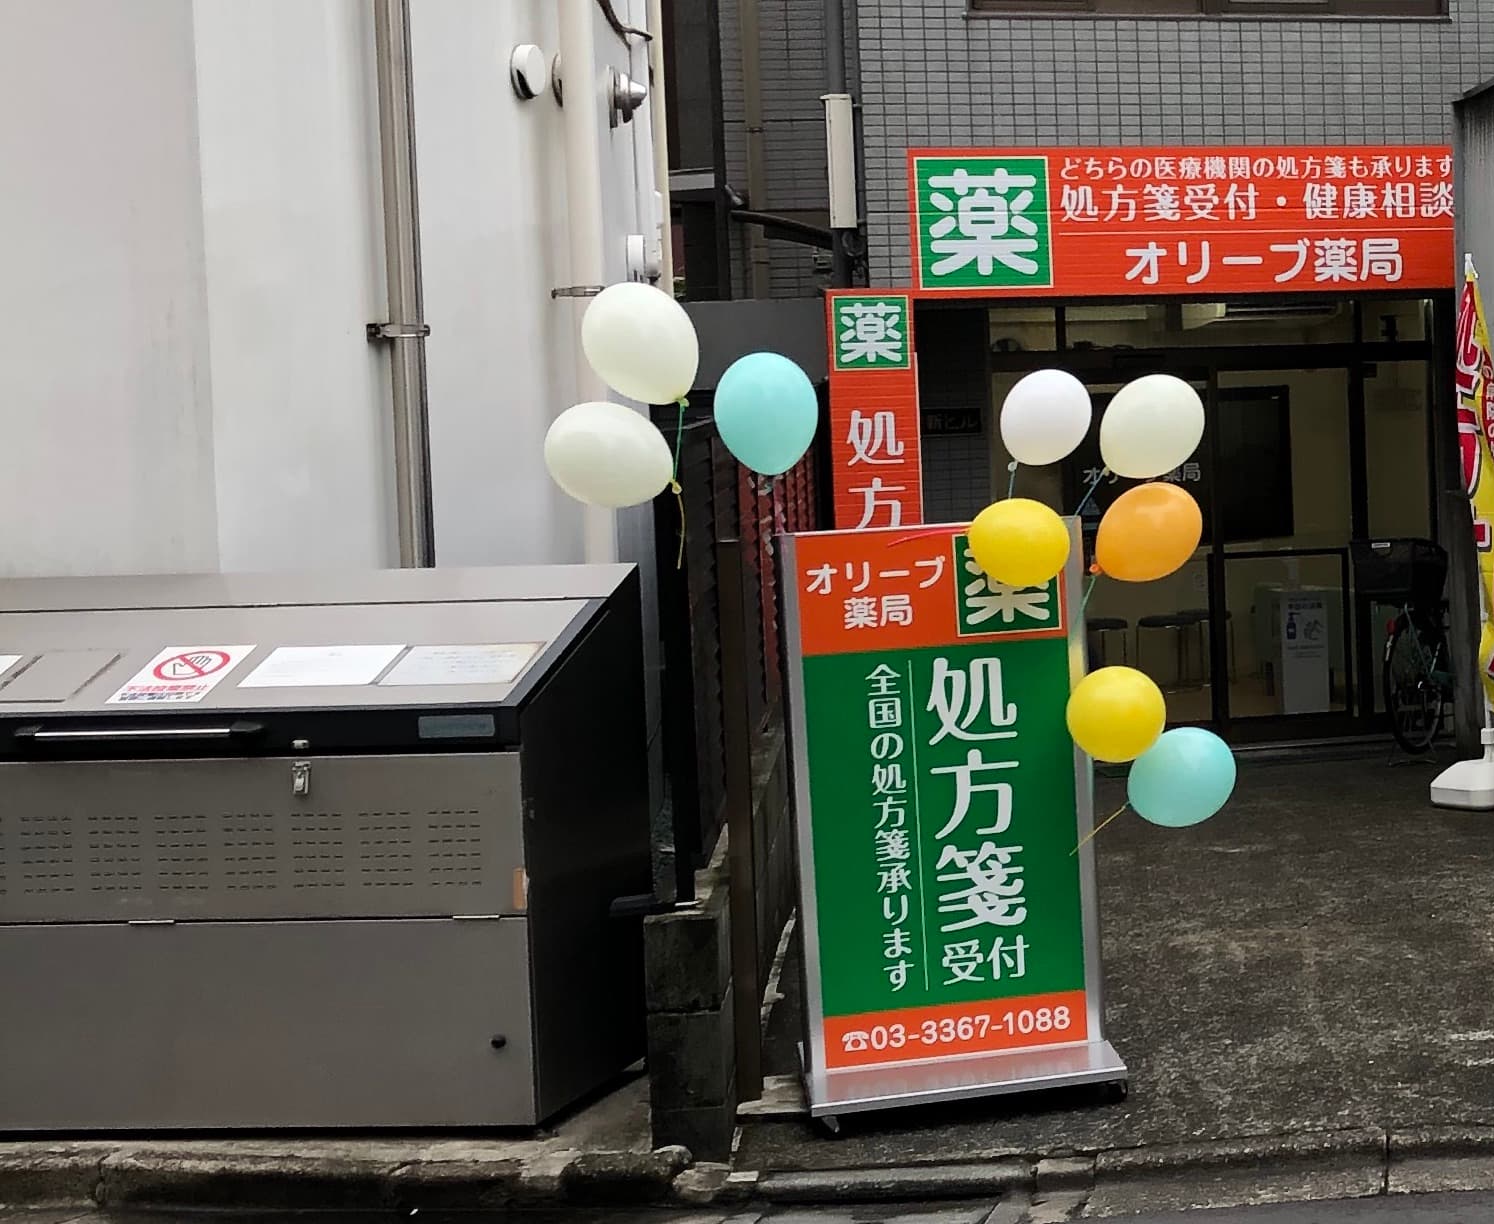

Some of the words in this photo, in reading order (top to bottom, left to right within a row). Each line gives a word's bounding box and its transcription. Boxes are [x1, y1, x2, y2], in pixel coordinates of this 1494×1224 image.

[1060, 155, 1453, 180] どちらの医療機関の処方箋も承ります
[928, 168, 1039, 276] 薬
[1124, 237, 1403, 284] オリーブ薬局
[840, 302, 902, 363] 薬
[805, 555, 946, 595] オリーブ
[843, 594, 914, 630] 薬局
[865, 663, 914, 992] 全国の処方箋承ります
[871, 1005, 1071, 1049] 03-3367-1088
